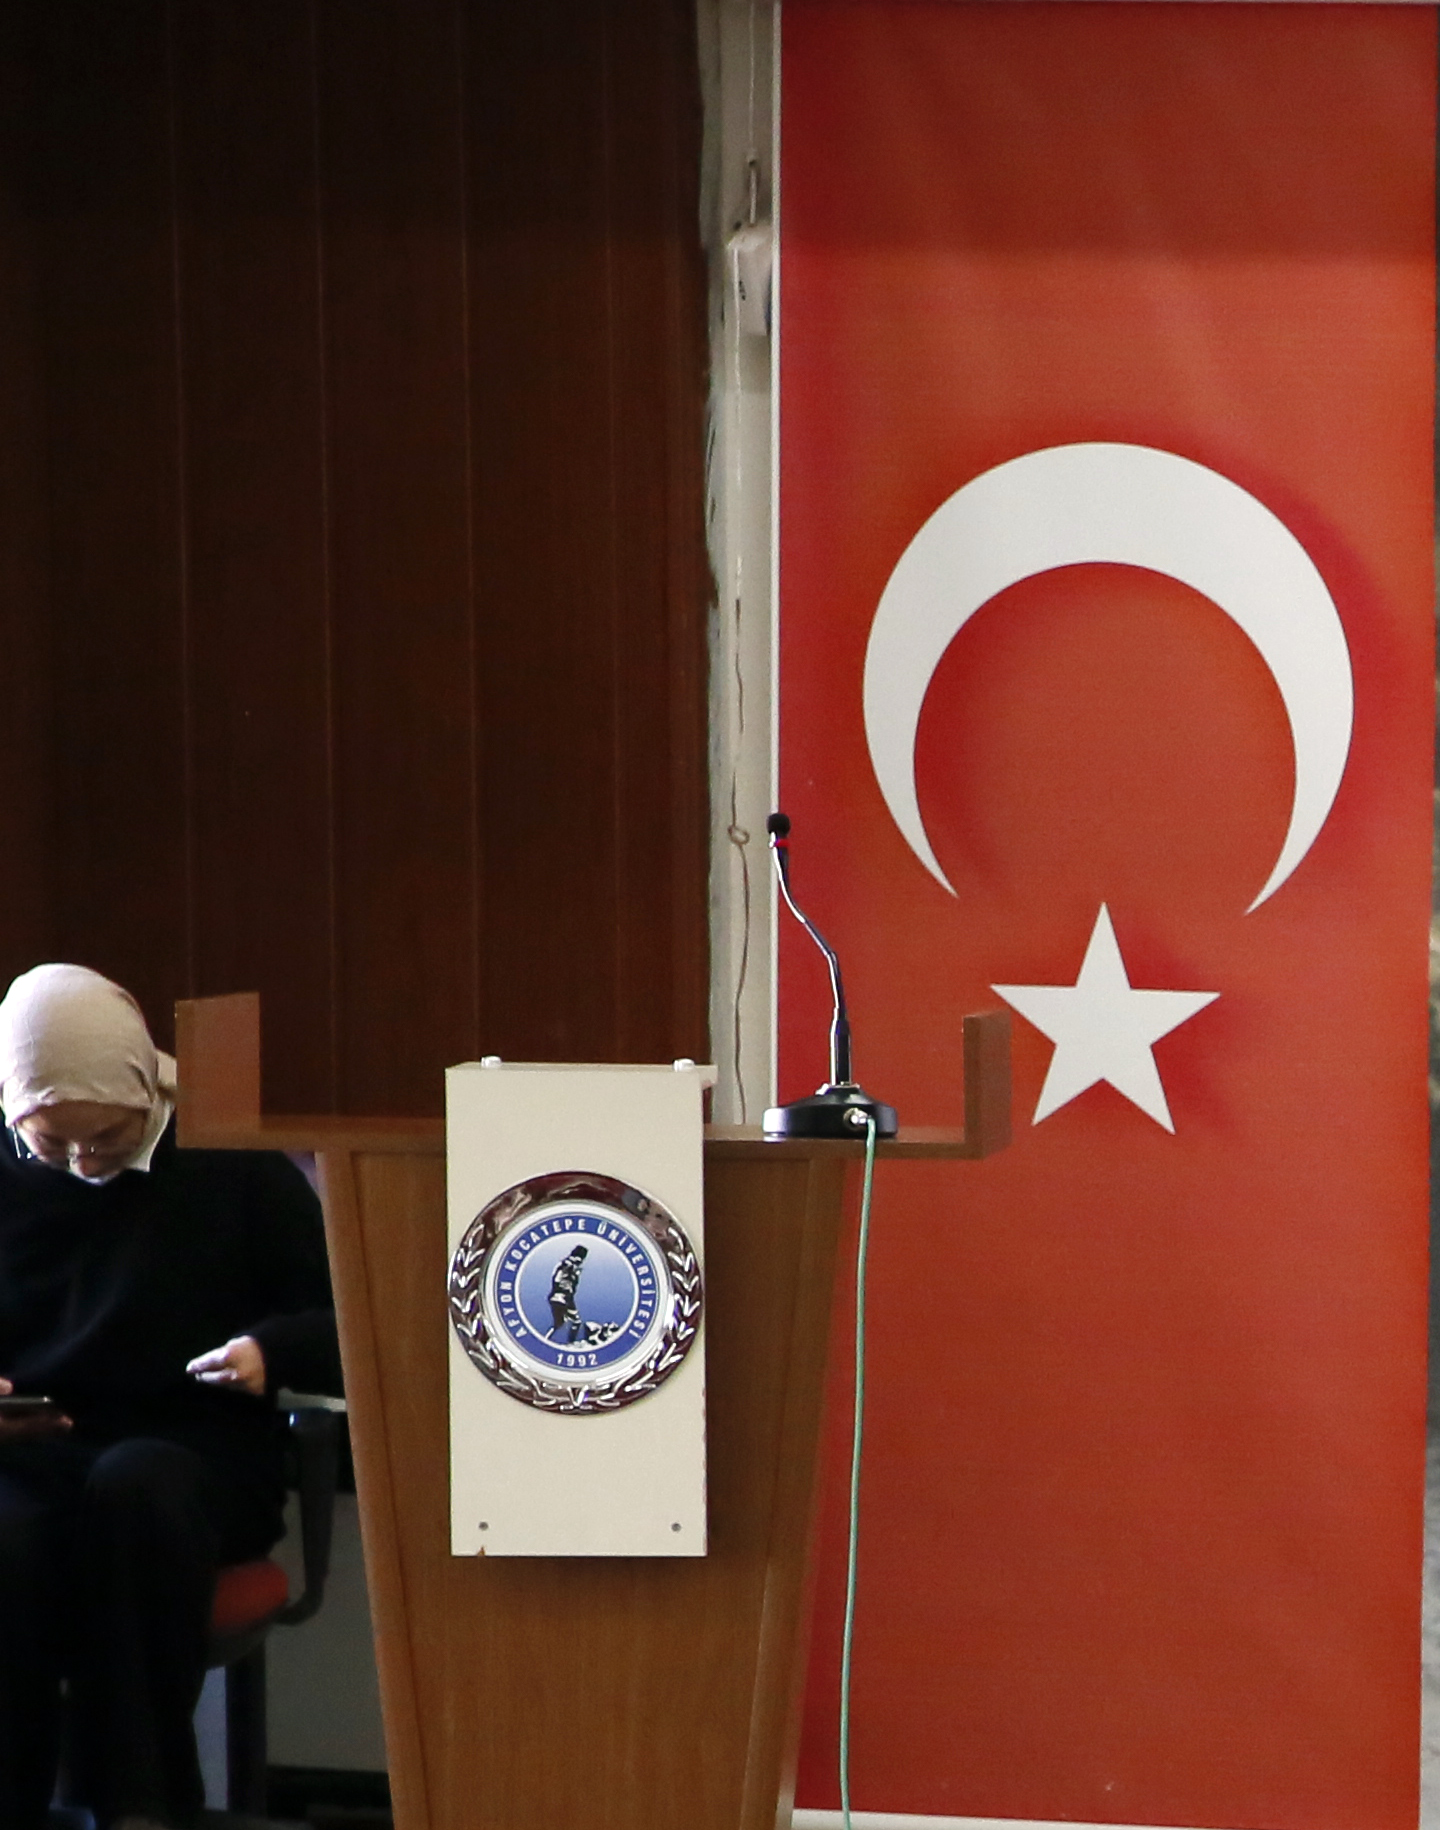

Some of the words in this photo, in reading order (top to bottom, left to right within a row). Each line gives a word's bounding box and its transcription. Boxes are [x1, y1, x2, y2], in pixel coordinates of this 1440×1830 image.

[505, 1219, 586, 1271] KOCATEPE
[500, 1282, 527, 1338] AFYON
[557, 1353, 597, 1366] 1992
